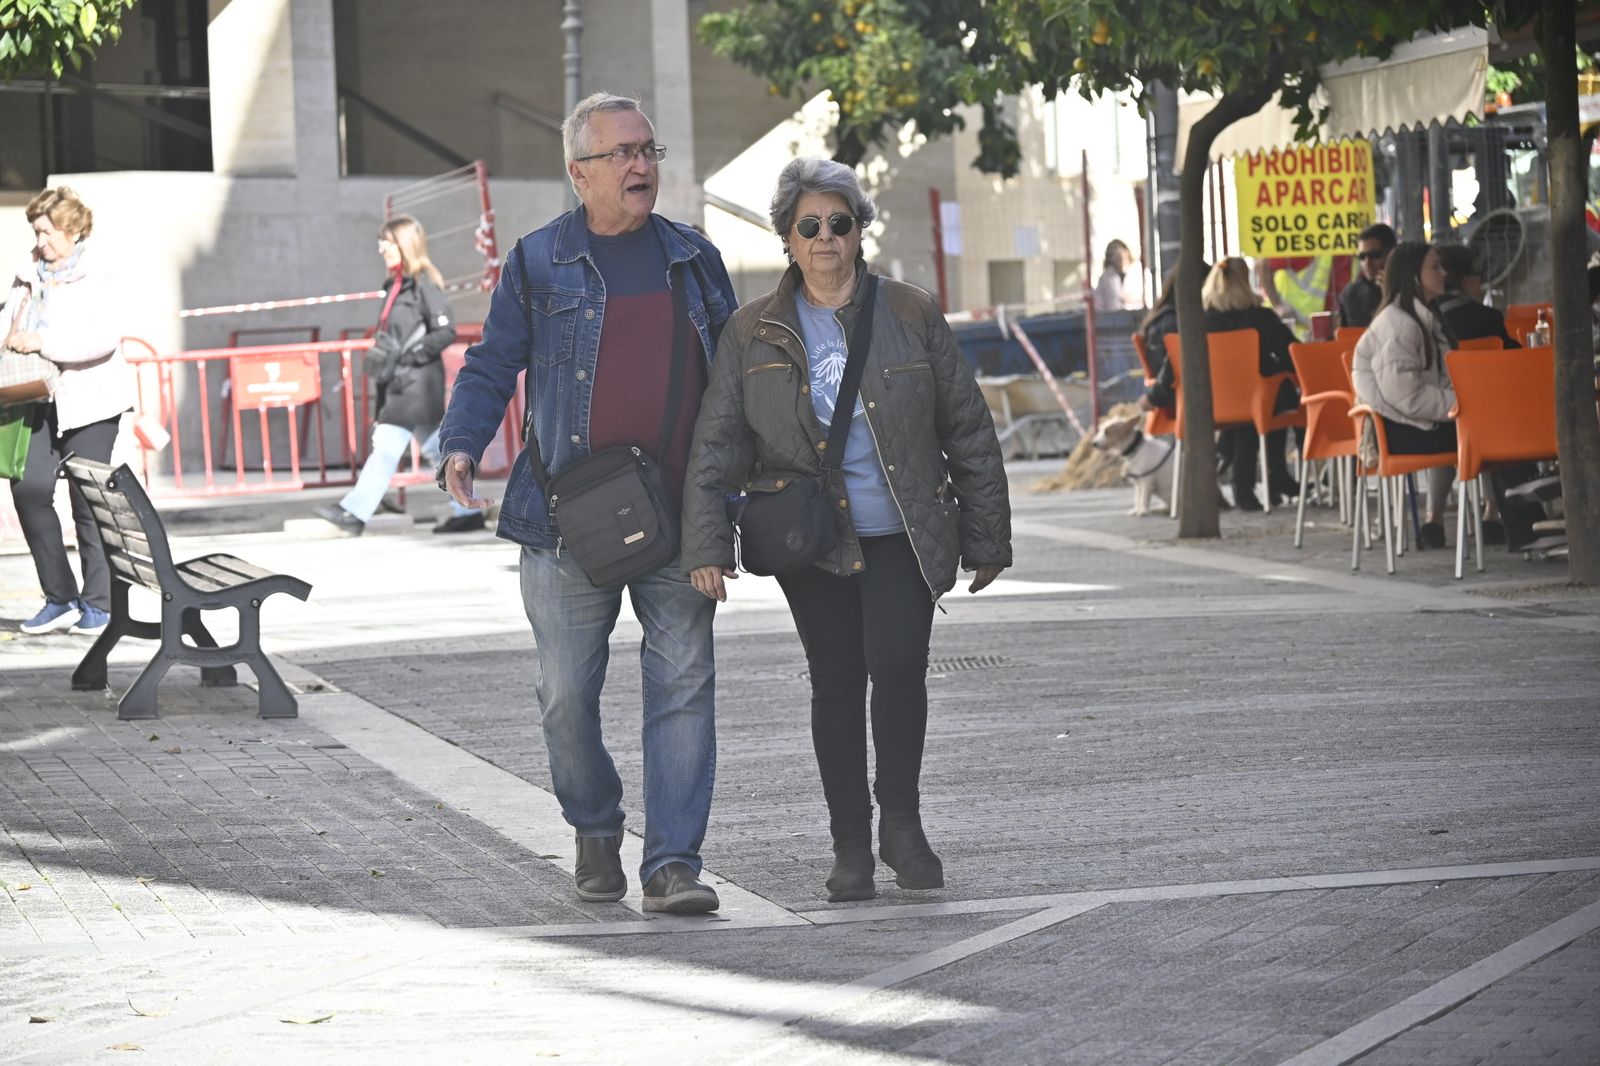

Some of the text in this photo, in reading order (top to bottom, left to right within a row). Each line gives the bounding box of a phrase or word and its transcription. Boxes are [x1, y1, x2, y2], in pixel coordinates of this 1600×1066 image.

[1251, 214, 1307, 232] SOLO
[1252, 233, 1358, 253] Y DESCAR
